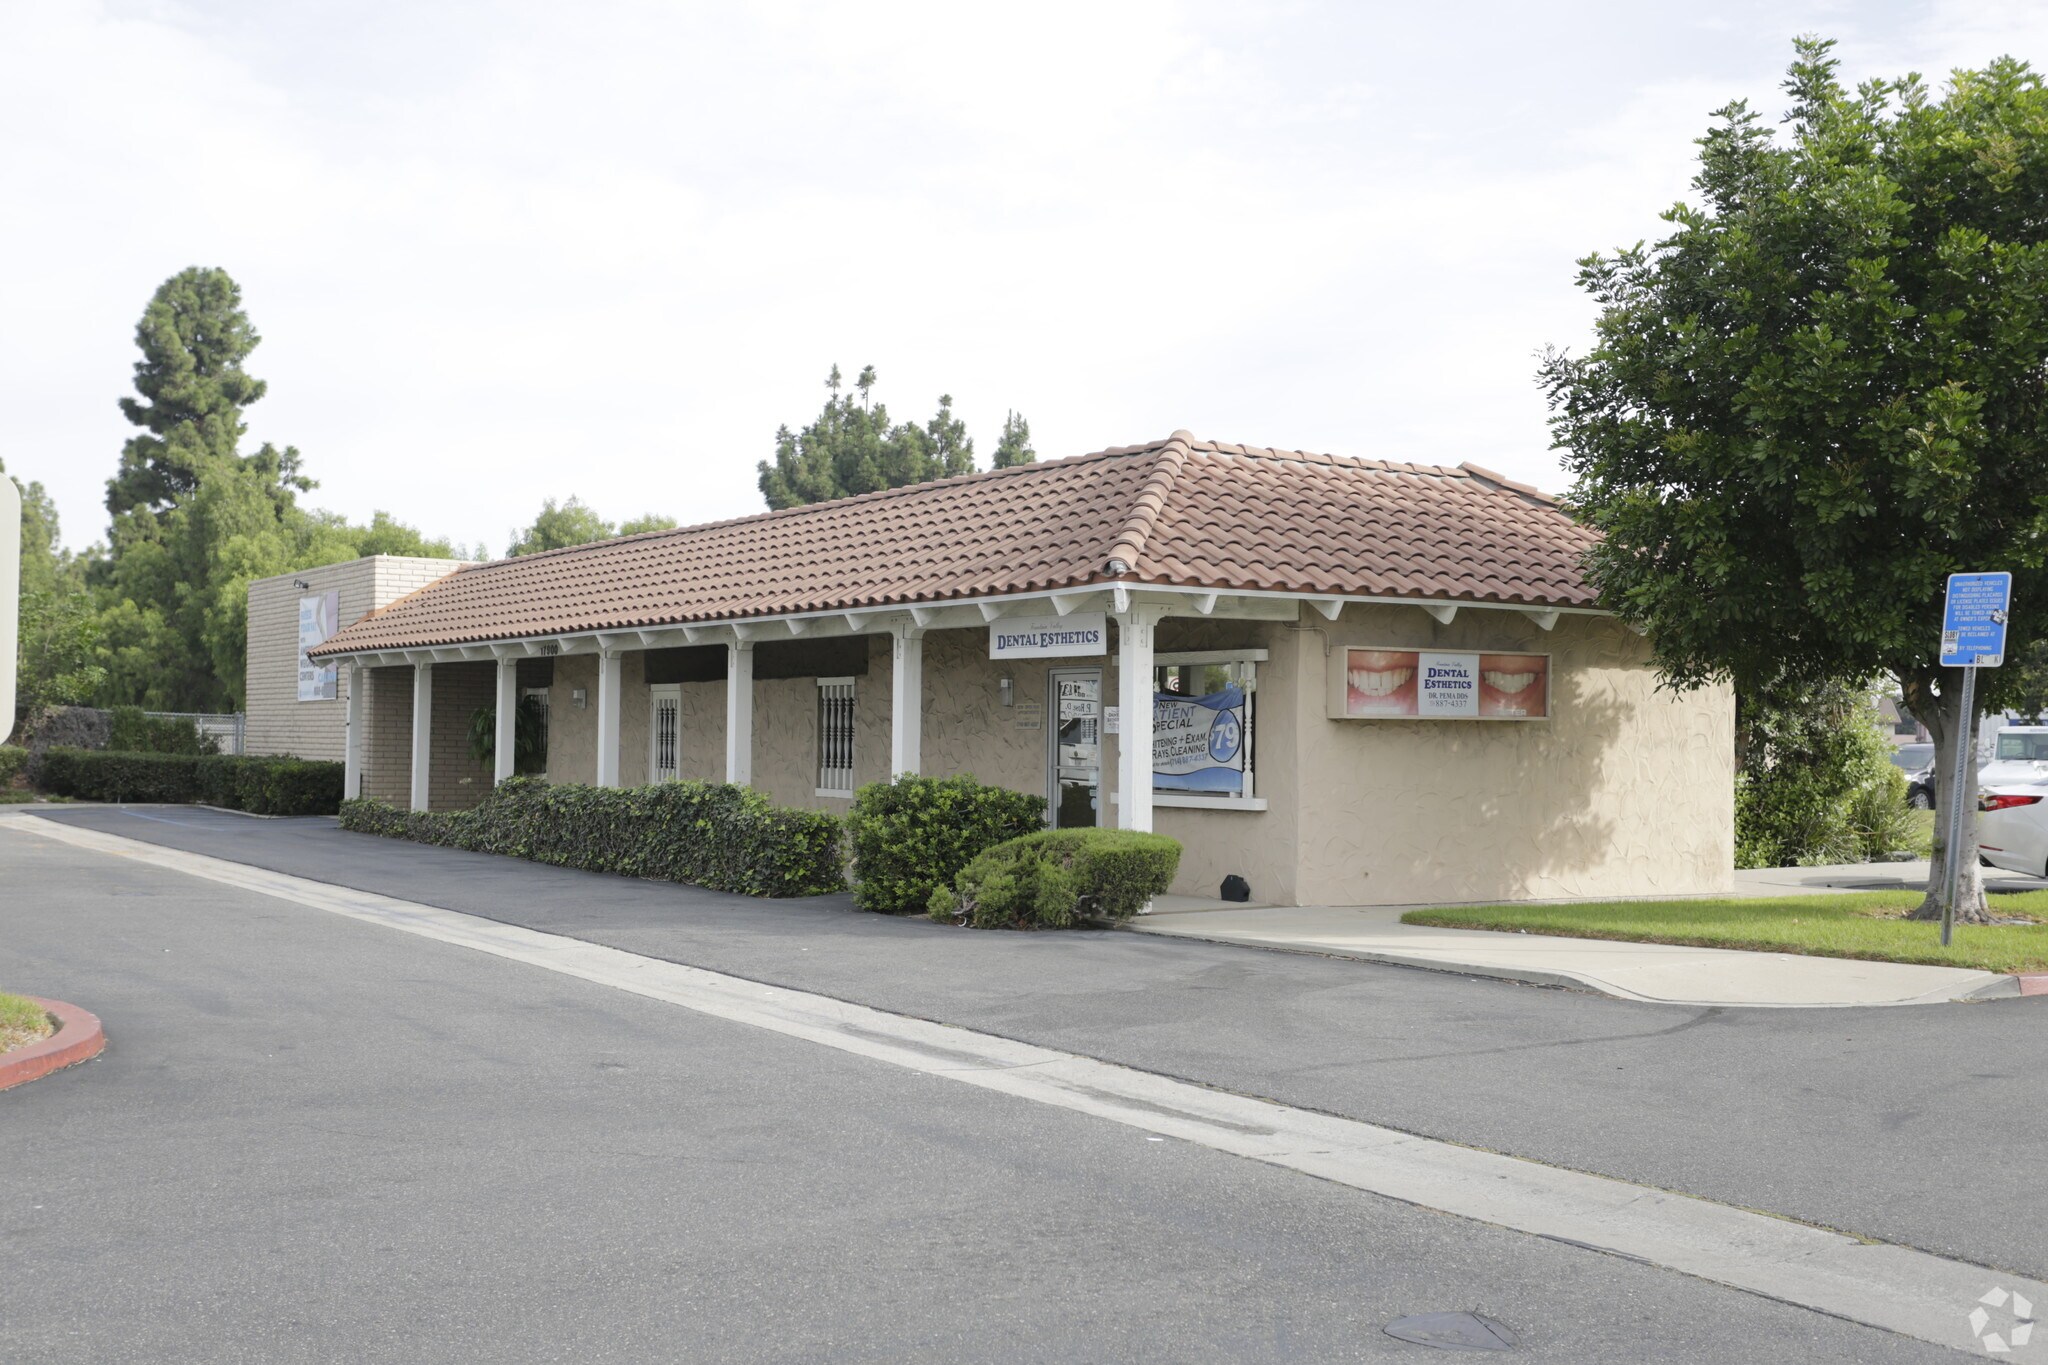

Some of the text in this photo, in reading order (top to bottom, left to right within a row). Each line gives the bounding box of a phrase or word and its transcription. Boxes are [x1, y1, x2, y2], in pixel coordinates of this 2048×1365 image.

[997, 630, 1099, 650] DENTAL ESTHETICS
[1428, 668, 1469, 678] DENTAL
[1424, 679, 1472, 689] ESTHETICS
[1153, 736, 1177, 749] ITENING
[1170, 744, 1205, 756] CLEANING
